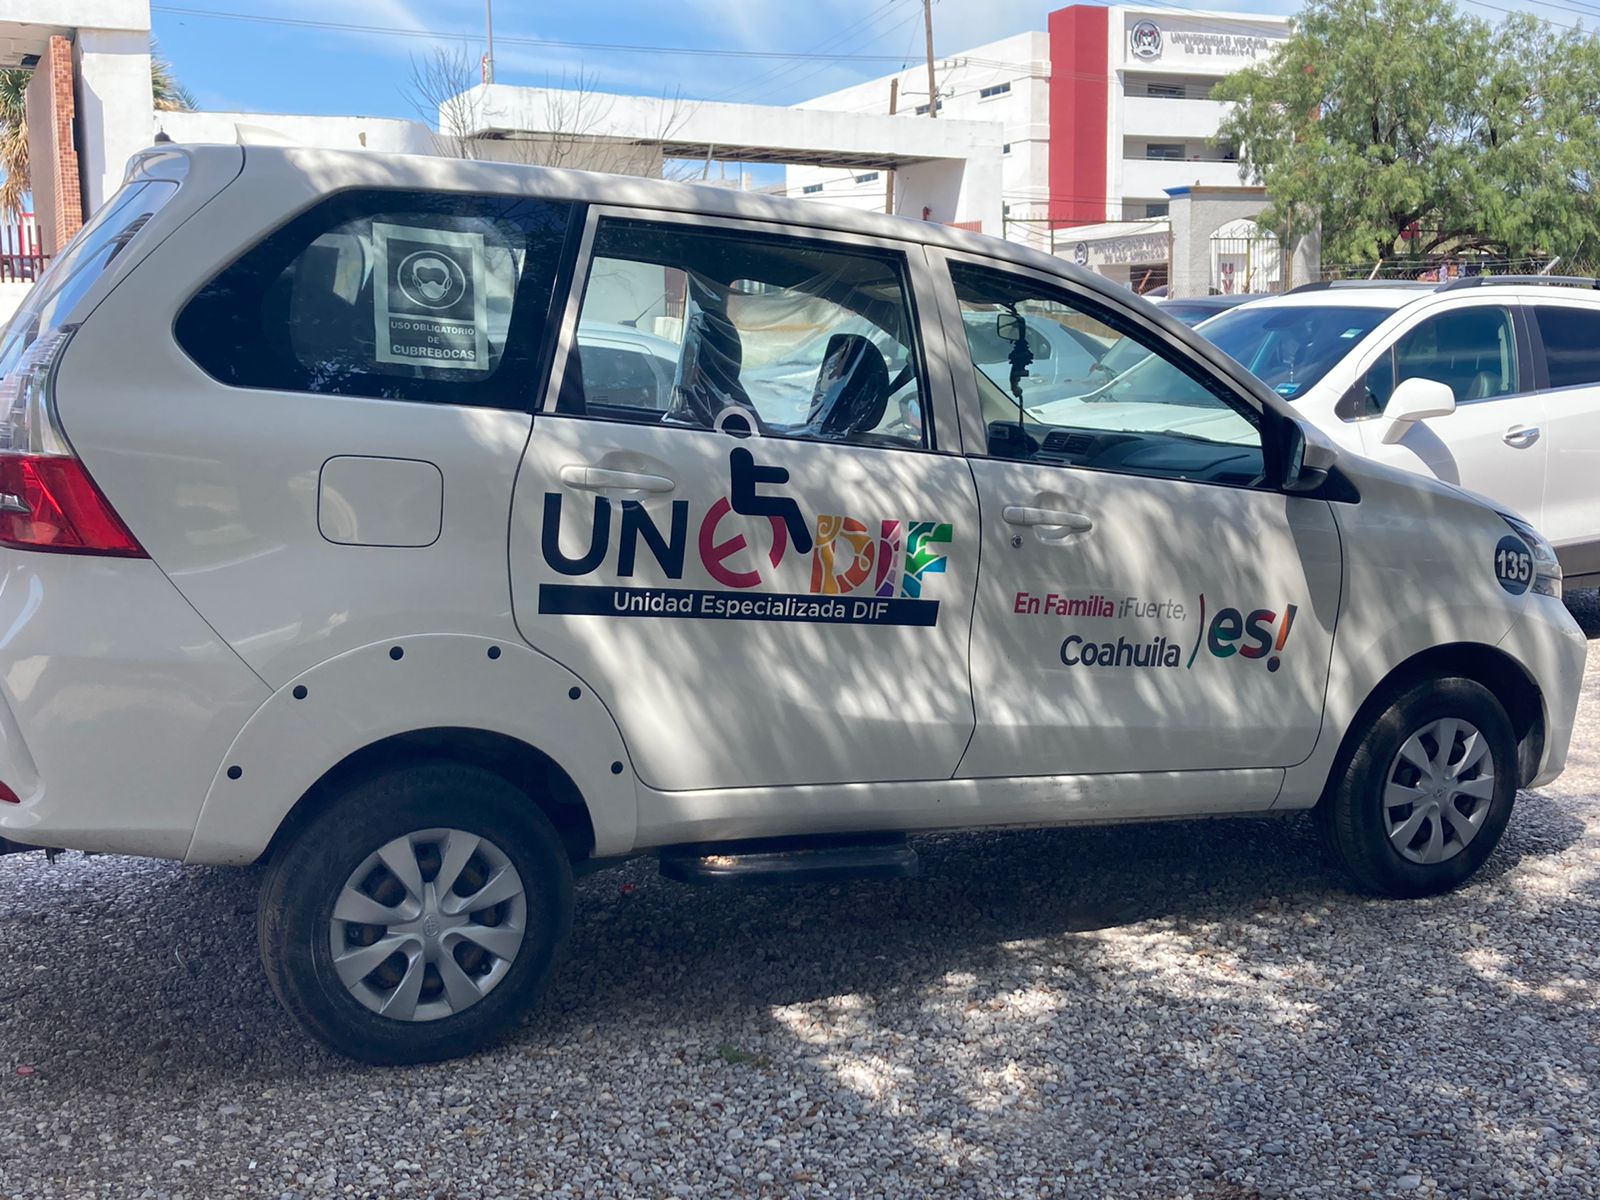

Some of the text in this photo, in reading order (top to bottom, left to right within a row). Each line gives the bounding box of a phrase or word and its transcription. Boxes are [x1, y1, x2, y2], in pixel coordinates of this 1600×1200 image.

[390, 320, 475, 336] USO OBLIGATORIO
[427, 335, 440, 344] DE
[392, 344, 476, 360] CUBREBOCAS
[1497, 549, 1530, 581] 135
[613, 591, 889, 619] Unidad Especializada DIF
[1014, 592, 1040, 614] En
[1044, 593, 1115, 618] Familia
[1060, 635, 1181, 668] Coahuila
[1207, 603, 1298, 673] es!
